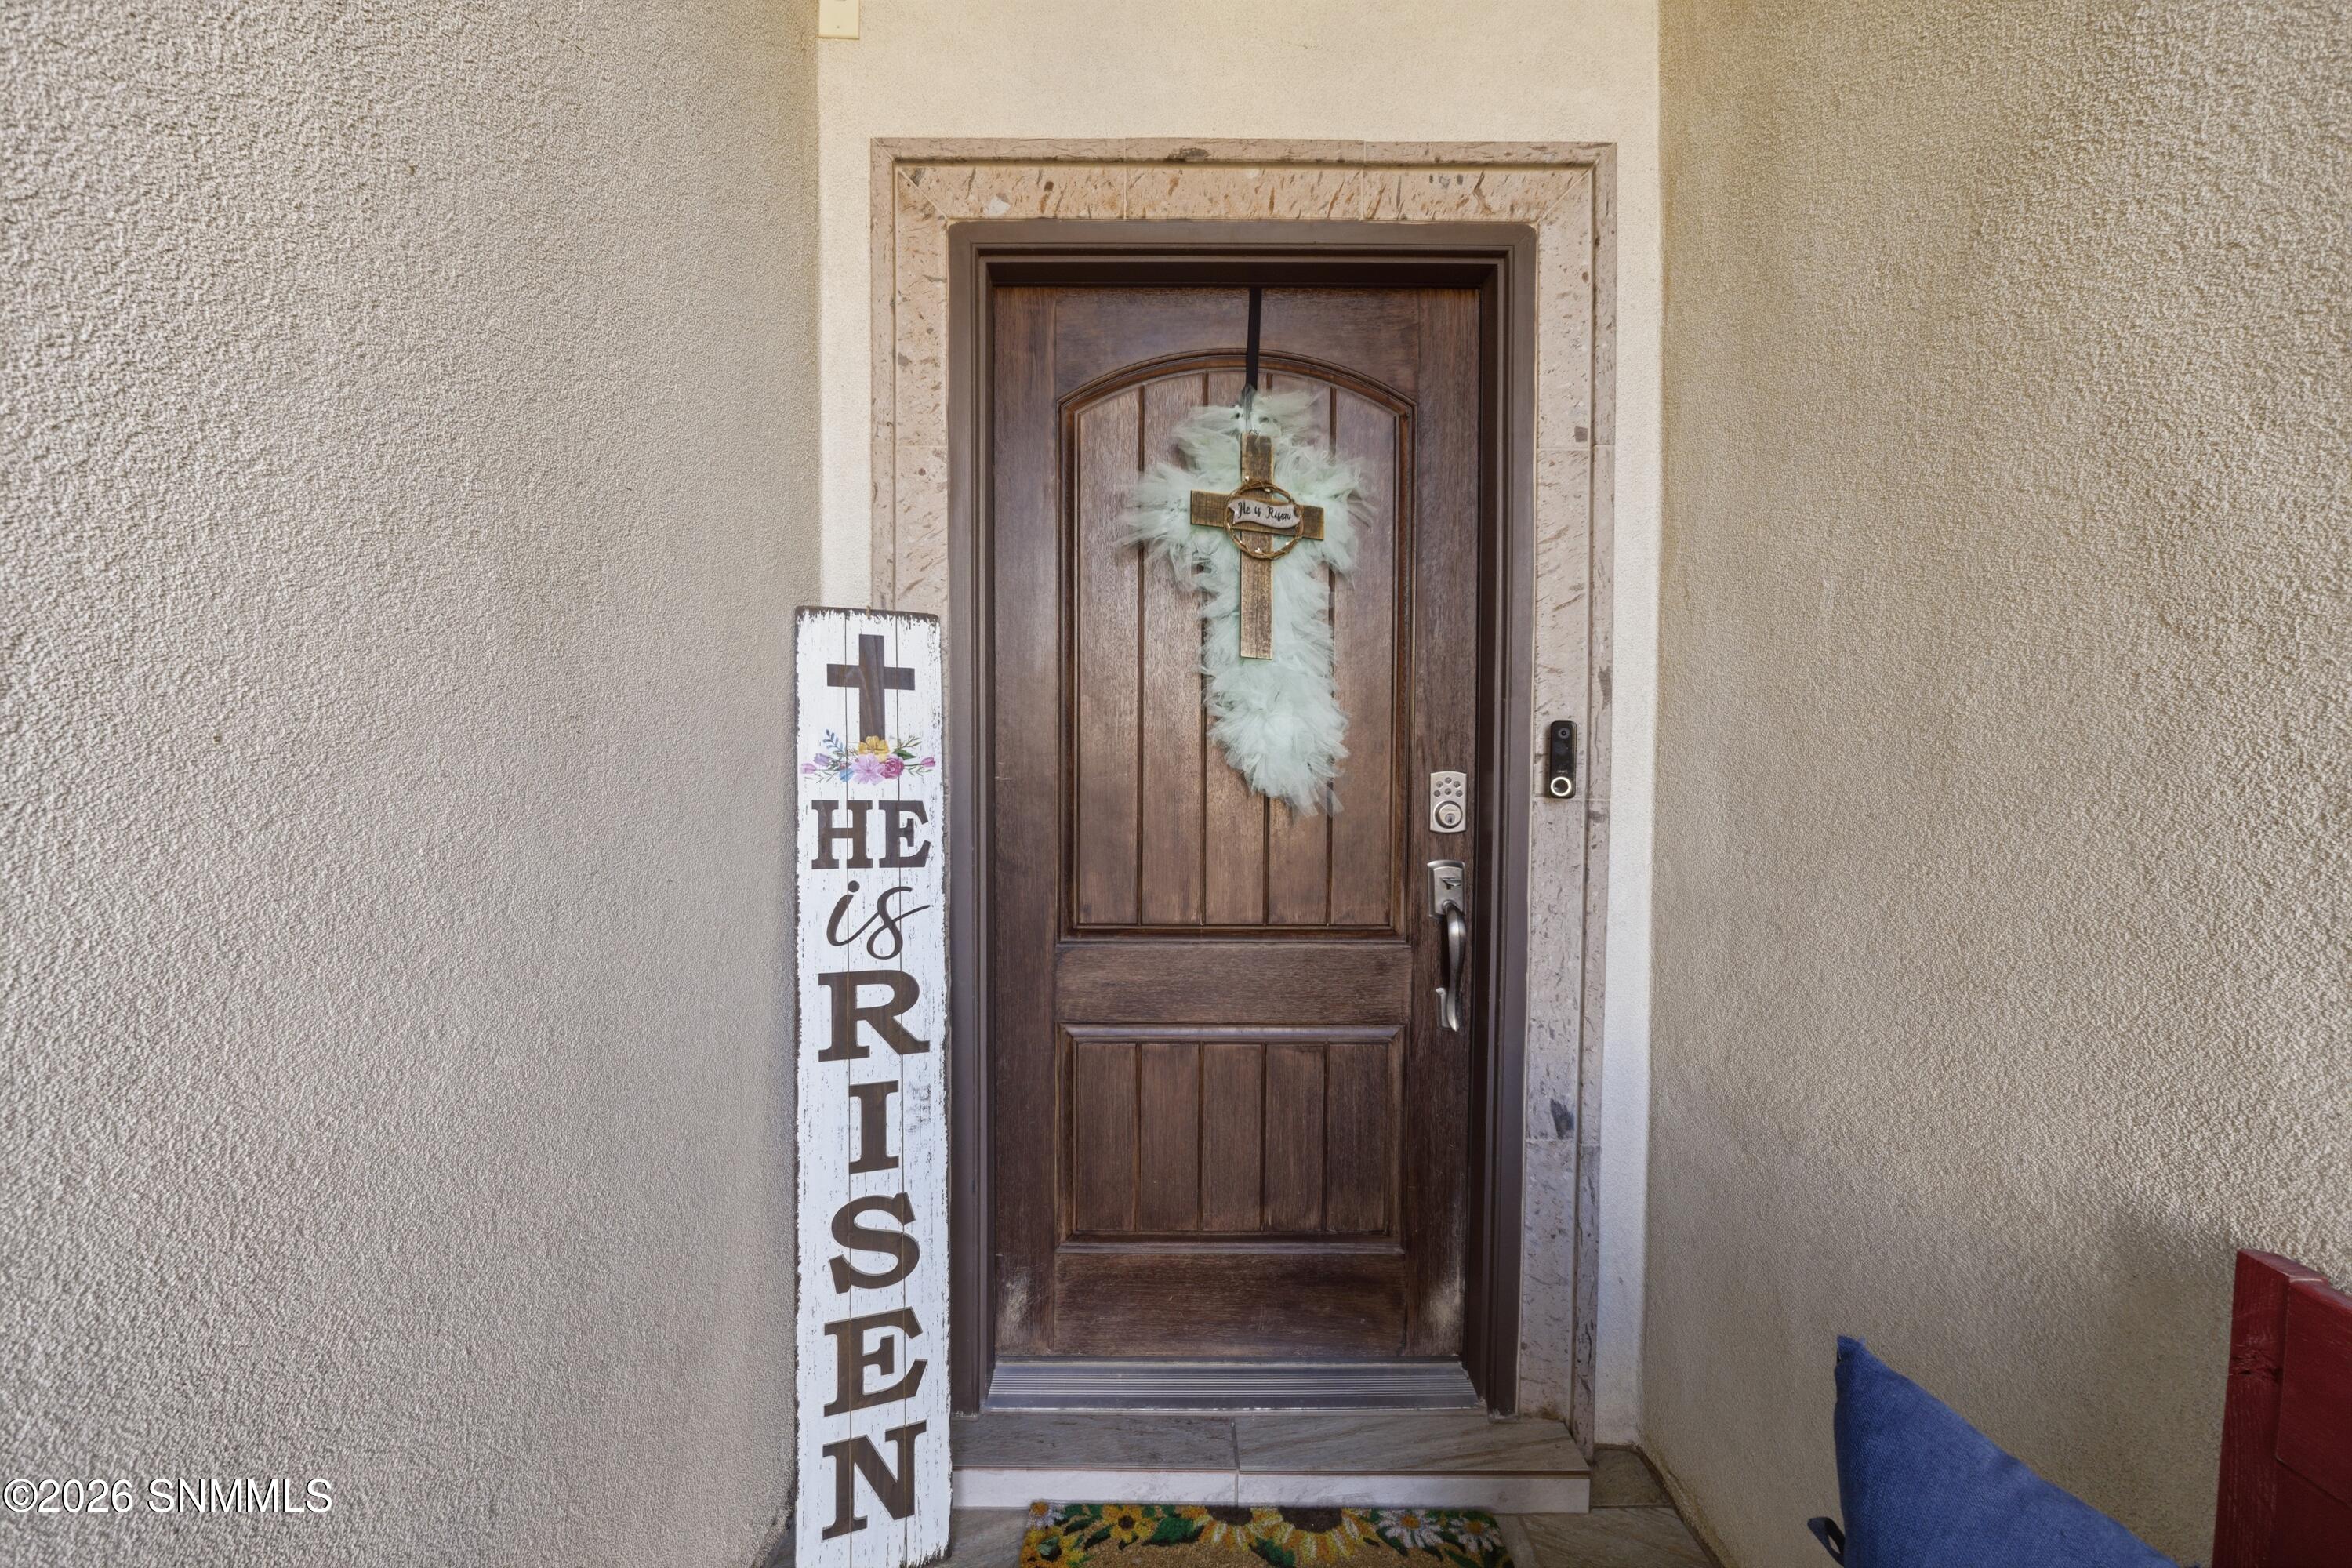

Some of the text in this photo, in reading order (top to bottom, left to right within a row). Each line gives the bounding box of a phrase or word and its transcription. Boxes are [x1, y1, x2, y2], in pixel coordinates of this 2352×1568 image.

[1238, 499, 1251, 519] He
[1266, 506, 1291, 522] Risen
[811, 799, 931, 869] HE
[826, 880, 931, 960] is
[818, 969, 931, 1543] RISEN
